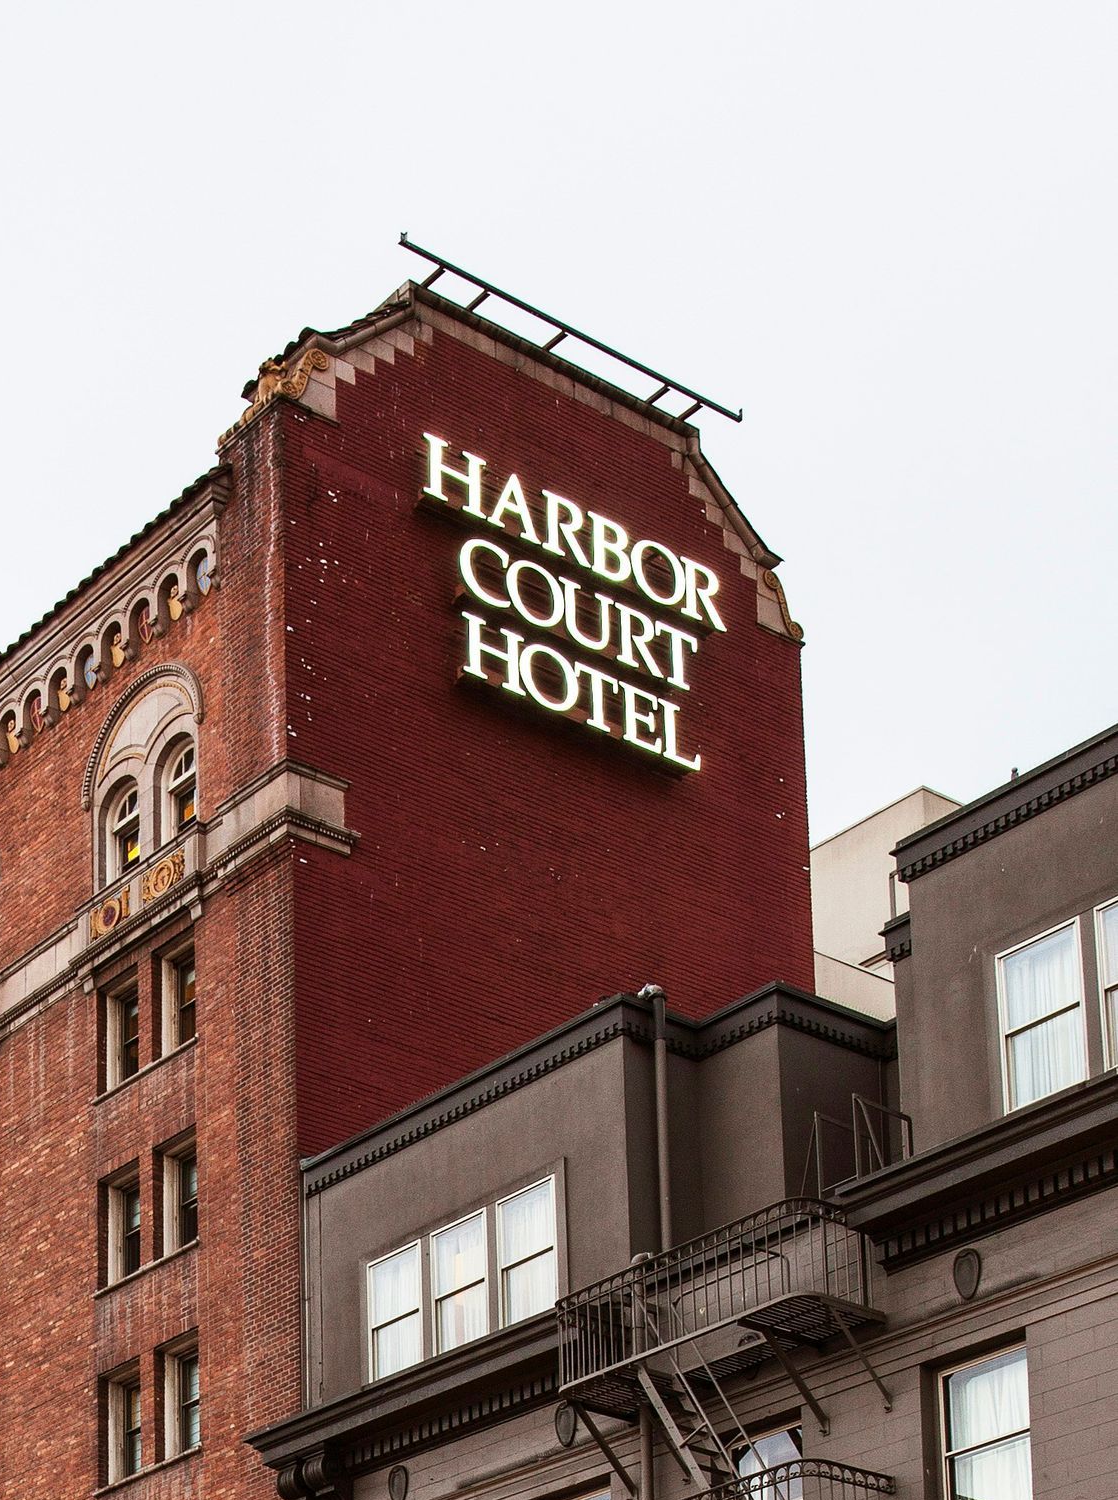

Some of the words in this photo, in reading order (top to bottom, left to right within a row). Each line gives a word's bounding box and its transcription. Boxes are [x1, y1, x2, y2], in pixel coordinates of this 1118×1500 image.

[422, 432, 728, 632] HARBOR
[459, 538, 698, 691] COURT
[461, 611, 701, 771] HOTEL
